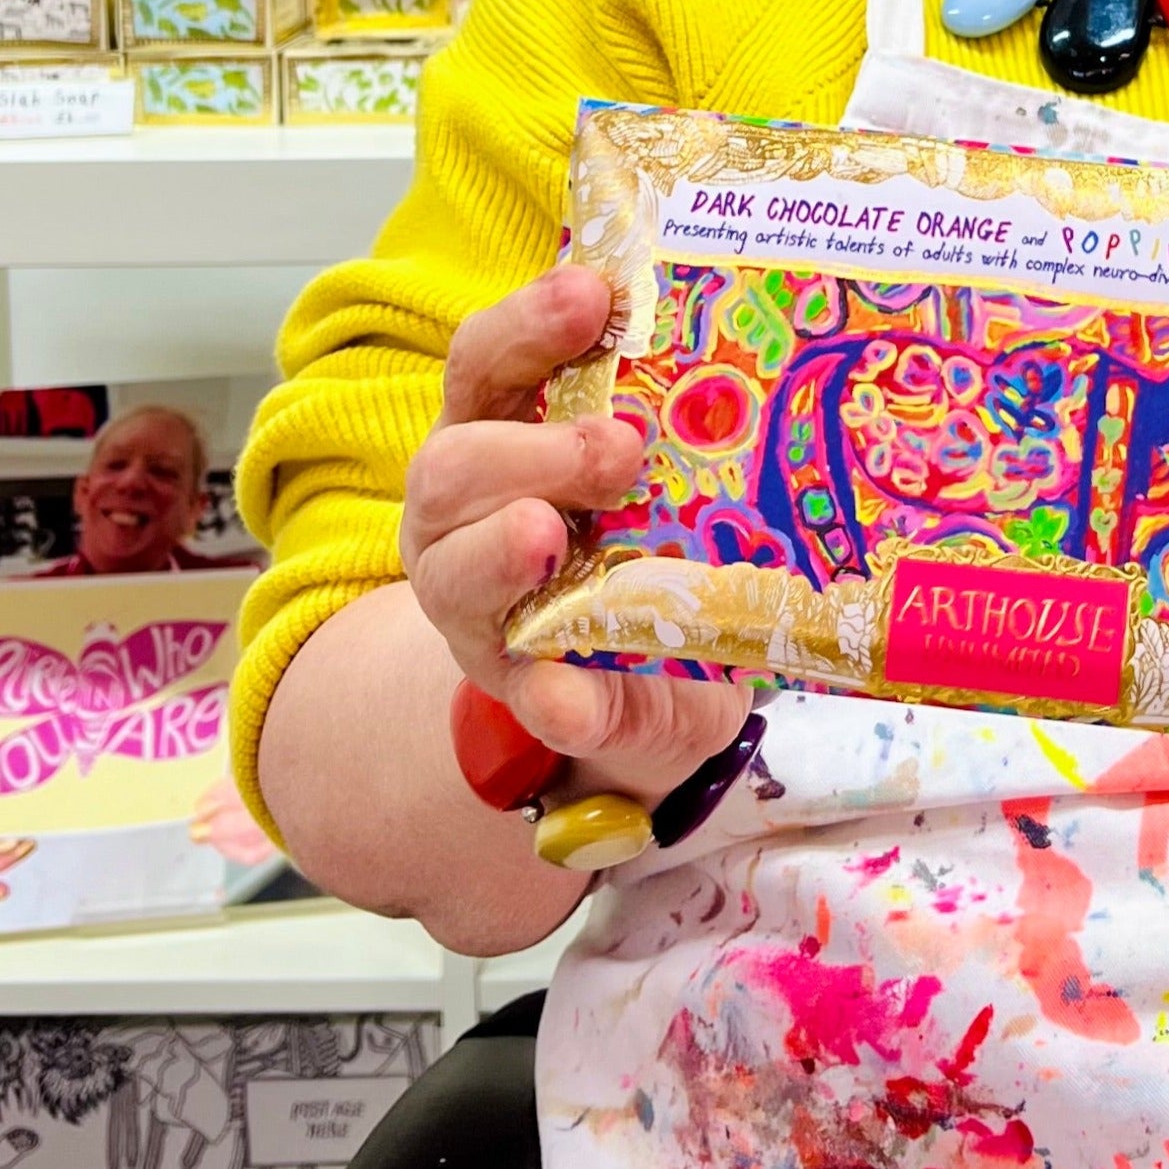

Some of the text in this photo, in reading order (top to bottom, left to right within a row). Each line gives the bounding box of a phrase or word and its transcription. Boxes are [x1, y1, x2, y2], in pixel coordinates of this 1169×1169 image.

[664, 219, 748, 254] Presenting
[755, 229, 817, 250] artistic
[826, 234, 885, 256] talents
[893, 236, 913, 257] of
[923, 243, 972, 266] adults
[981, 248, 1018, 269] with
[1026, 258, 1085, 284] complex
[691, 191, 754, 218] DARK
[767, 197, 904, 233] CHOCOLATE
[917, 212, 1012, 243] ORANGE
[1021, 231, 1047, 247] and
[896, 585, 1118, 653] ARTHOUSE
